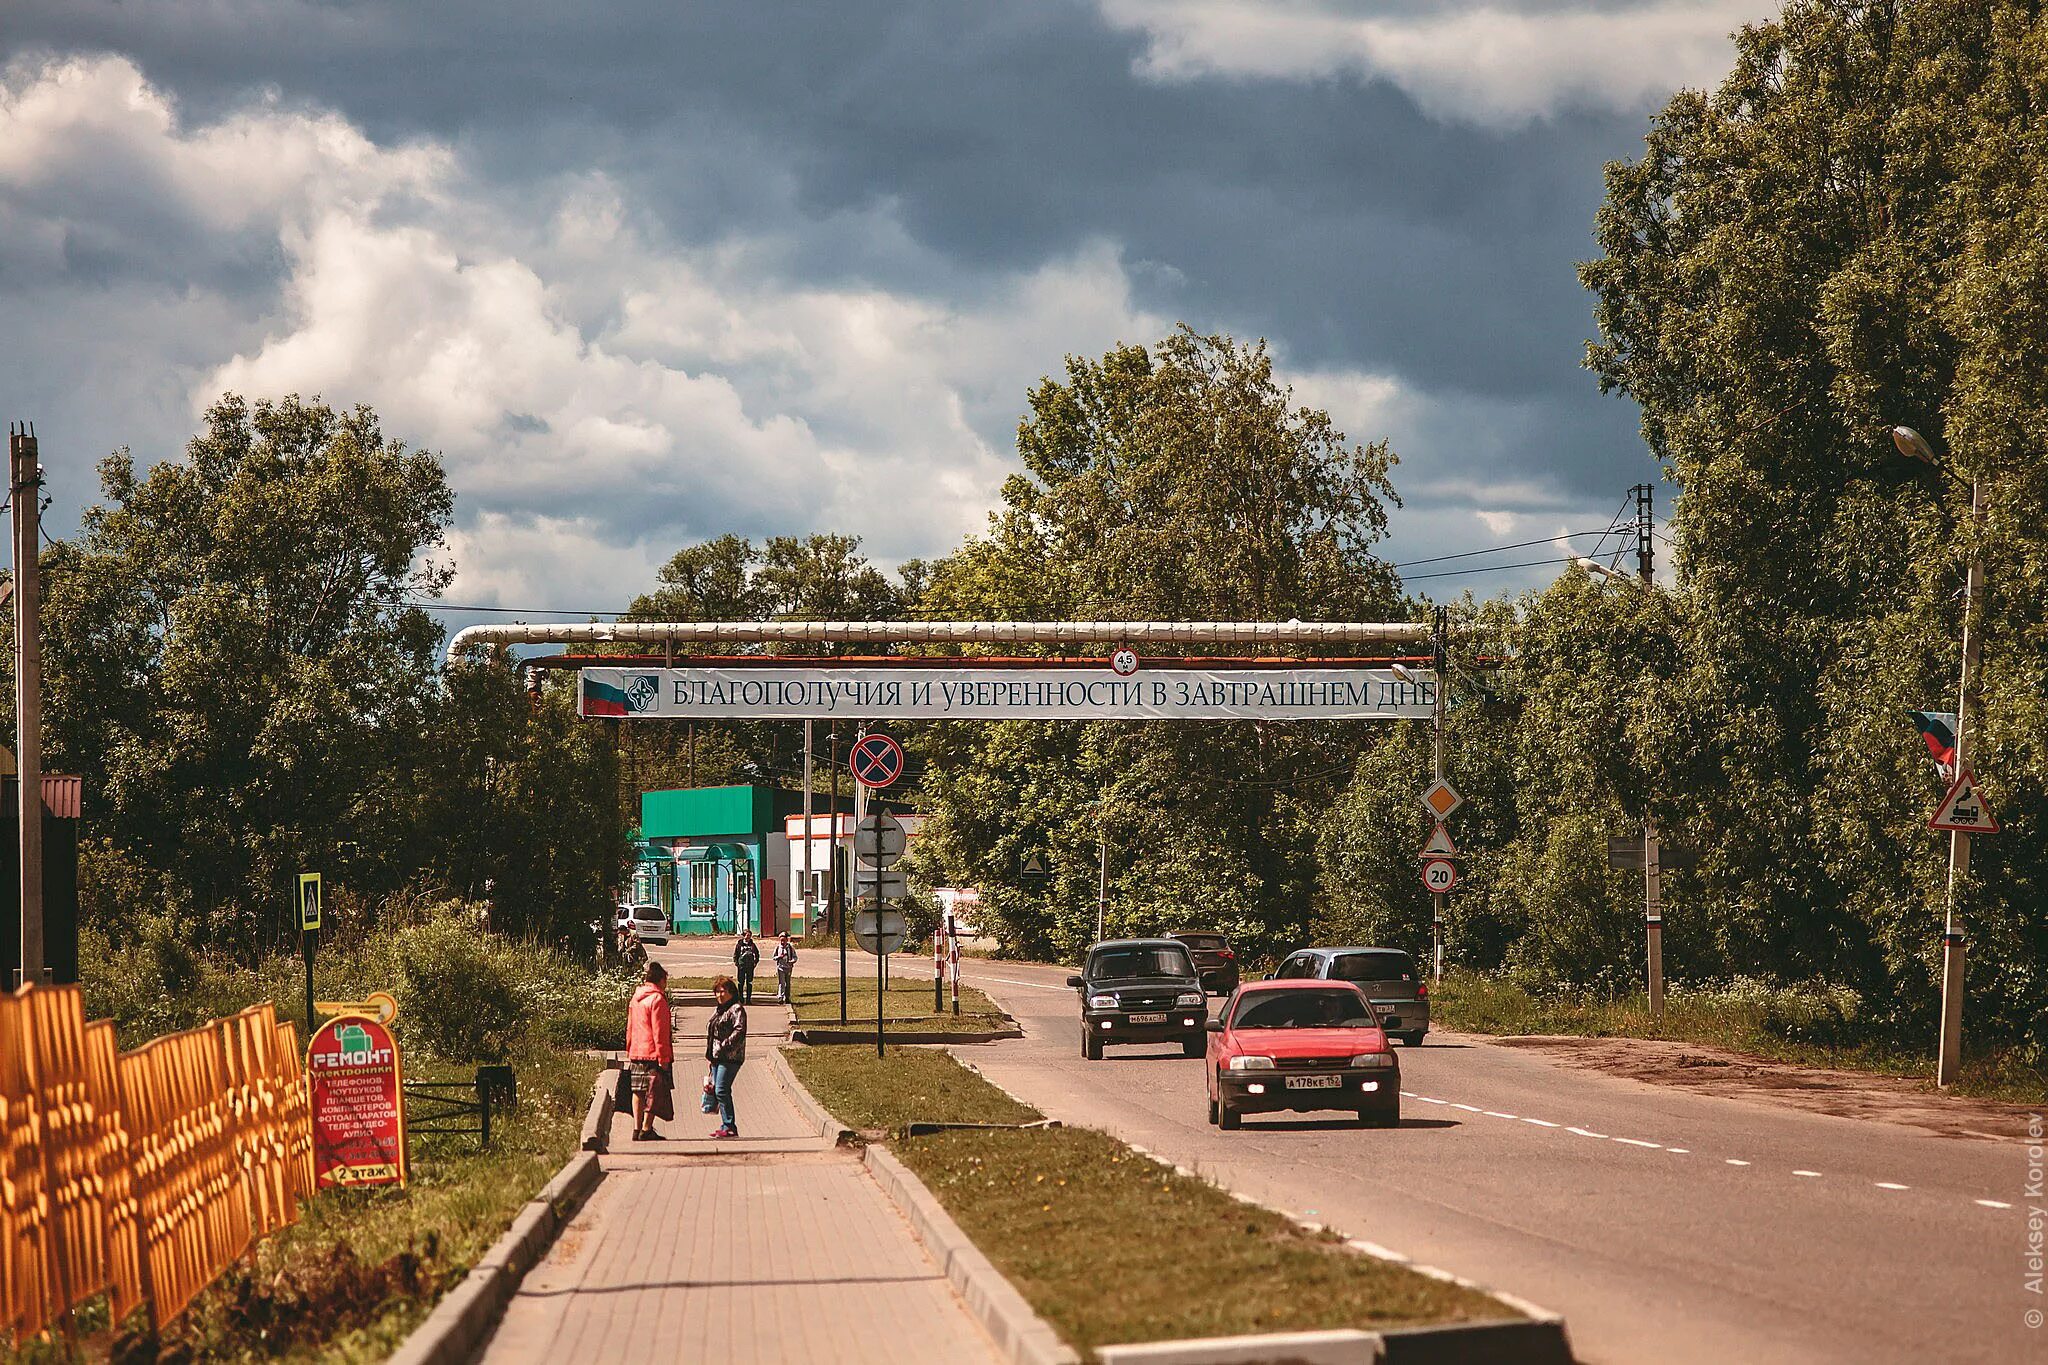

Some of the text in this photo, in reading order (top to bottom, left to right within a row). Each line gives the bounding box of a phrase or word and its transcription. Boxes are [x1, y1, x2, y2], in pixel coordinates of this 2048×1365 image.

[1118, 655, 1132, 664] 4,5
[672, 680, 902, 711] БЛАГОПОЛУЧИЯ
[911, 680, 934, 706] И
[943, 681, 1144, 711] УВЕРЕННОСТИ
[1151, 681, 1168, 706] В
[1175, 681, 1370, 707] ЗАВТРАШНЕМ
[1431, 870, 1449, 884] 20
[313, 1048, 392, 1069] РЕМОНТ
[338, 1167, 347, 1180] 2
